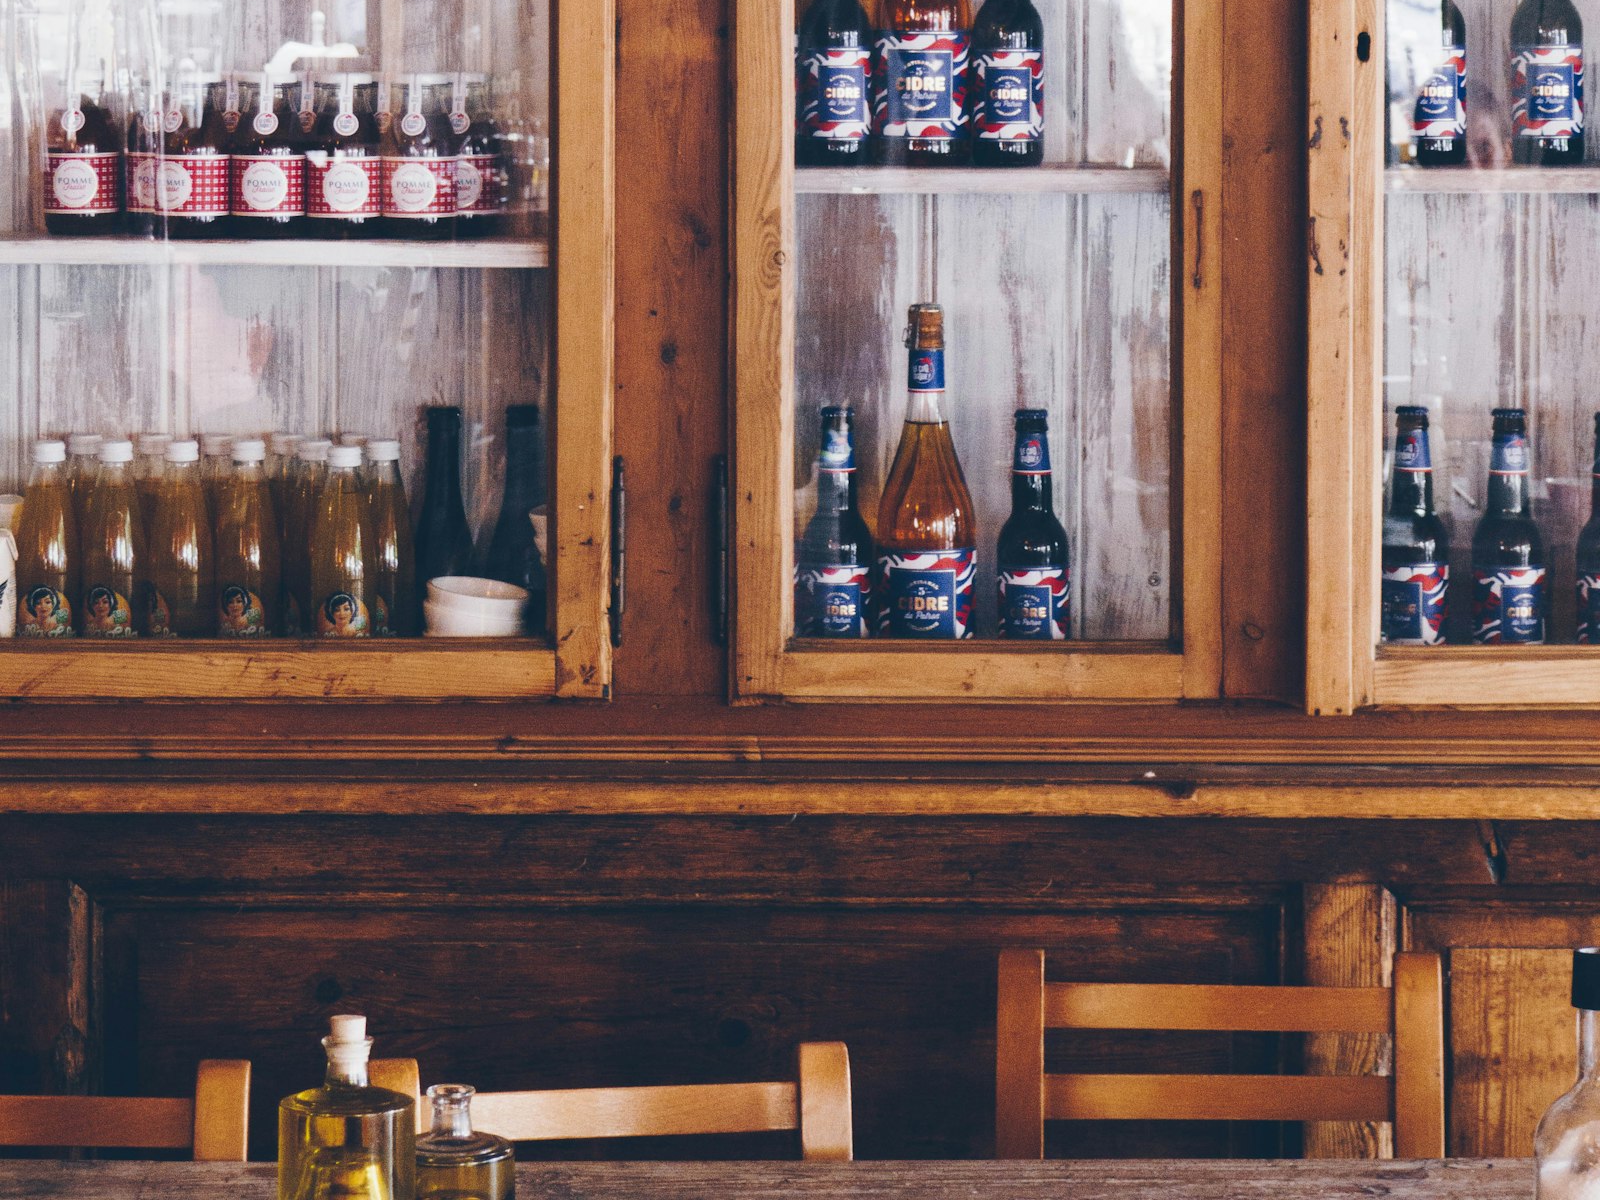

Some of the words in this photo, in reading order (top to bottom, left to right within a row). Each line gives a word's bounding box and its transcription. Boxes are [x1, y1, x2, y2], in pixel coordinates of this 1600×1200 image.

[895, 76, 947, 92] CIDRE
[825, 87, 861, 99] CIDRE
[990, 88, 1028, 100] CIDRE
[1532, 84, 1570, 97] CIDRE
[826, 604, 857, 616] IDRE
[897, 596, 949, 612] CIDRE
